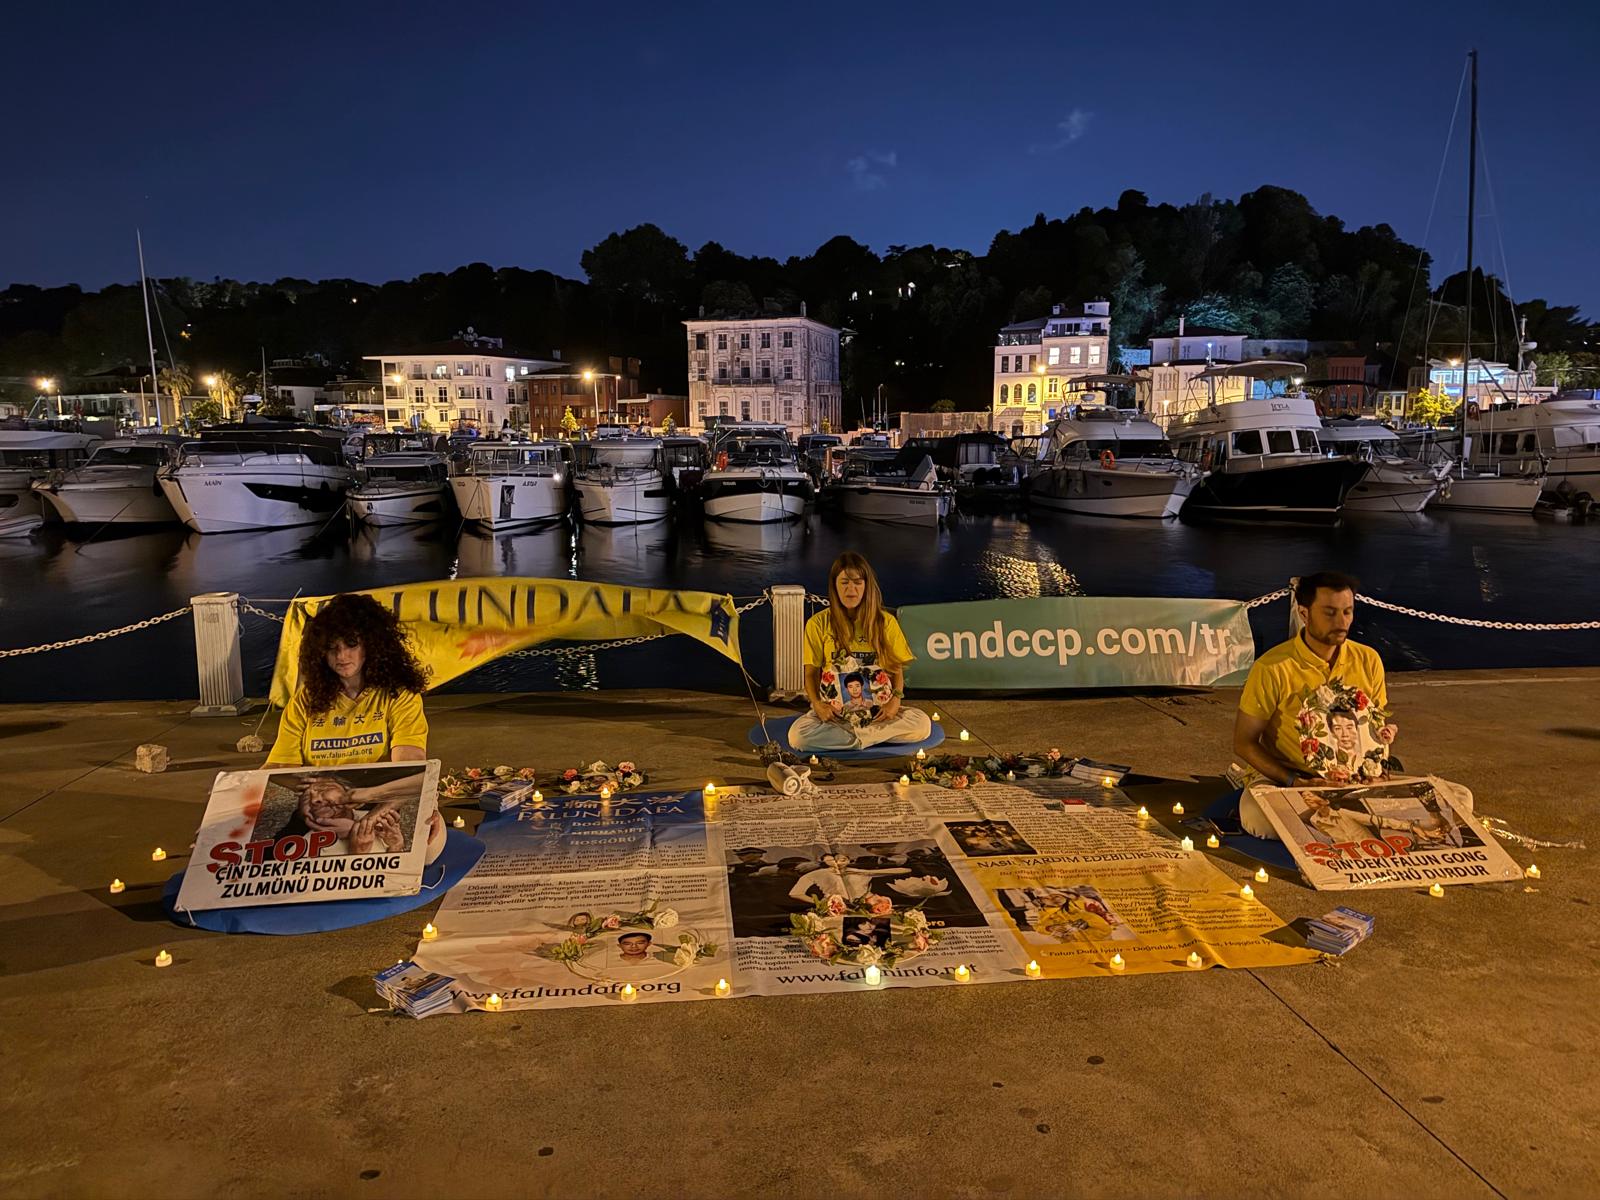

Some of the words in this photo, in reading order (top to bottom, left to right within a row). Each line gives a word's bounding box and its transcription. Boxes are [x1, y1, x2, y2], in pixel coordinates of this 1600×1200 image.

[926, 620, 1232, 666] endccp.com/tr
[313, 740, 349, 749] FALUN
[351, 735, 380, 746] DAFA
[614, 806, 685, 817] DAFA
[206, 830, 337, 873] STOP
[1304, 836, 1413, 866] STOP
[1326, 857, 1392, 873] ÇİN'DEKİ
[1393, 853, 1442, 868] FALUN
[1443, 850, 1489, 864] GONG
[215, 859, 290, 884] ÇİN'DEKİ
[291, 858, 347, 876] FALUN
[350, 855, 401, 872] GONG
[1425, 864, 1490, 879] DURDUR
[220, 877, 309, 899] ZULMÜNÜ
[312, 874, 385, 892] DURDUR
[776, 963, 977, 984] www.falninfo.nt
